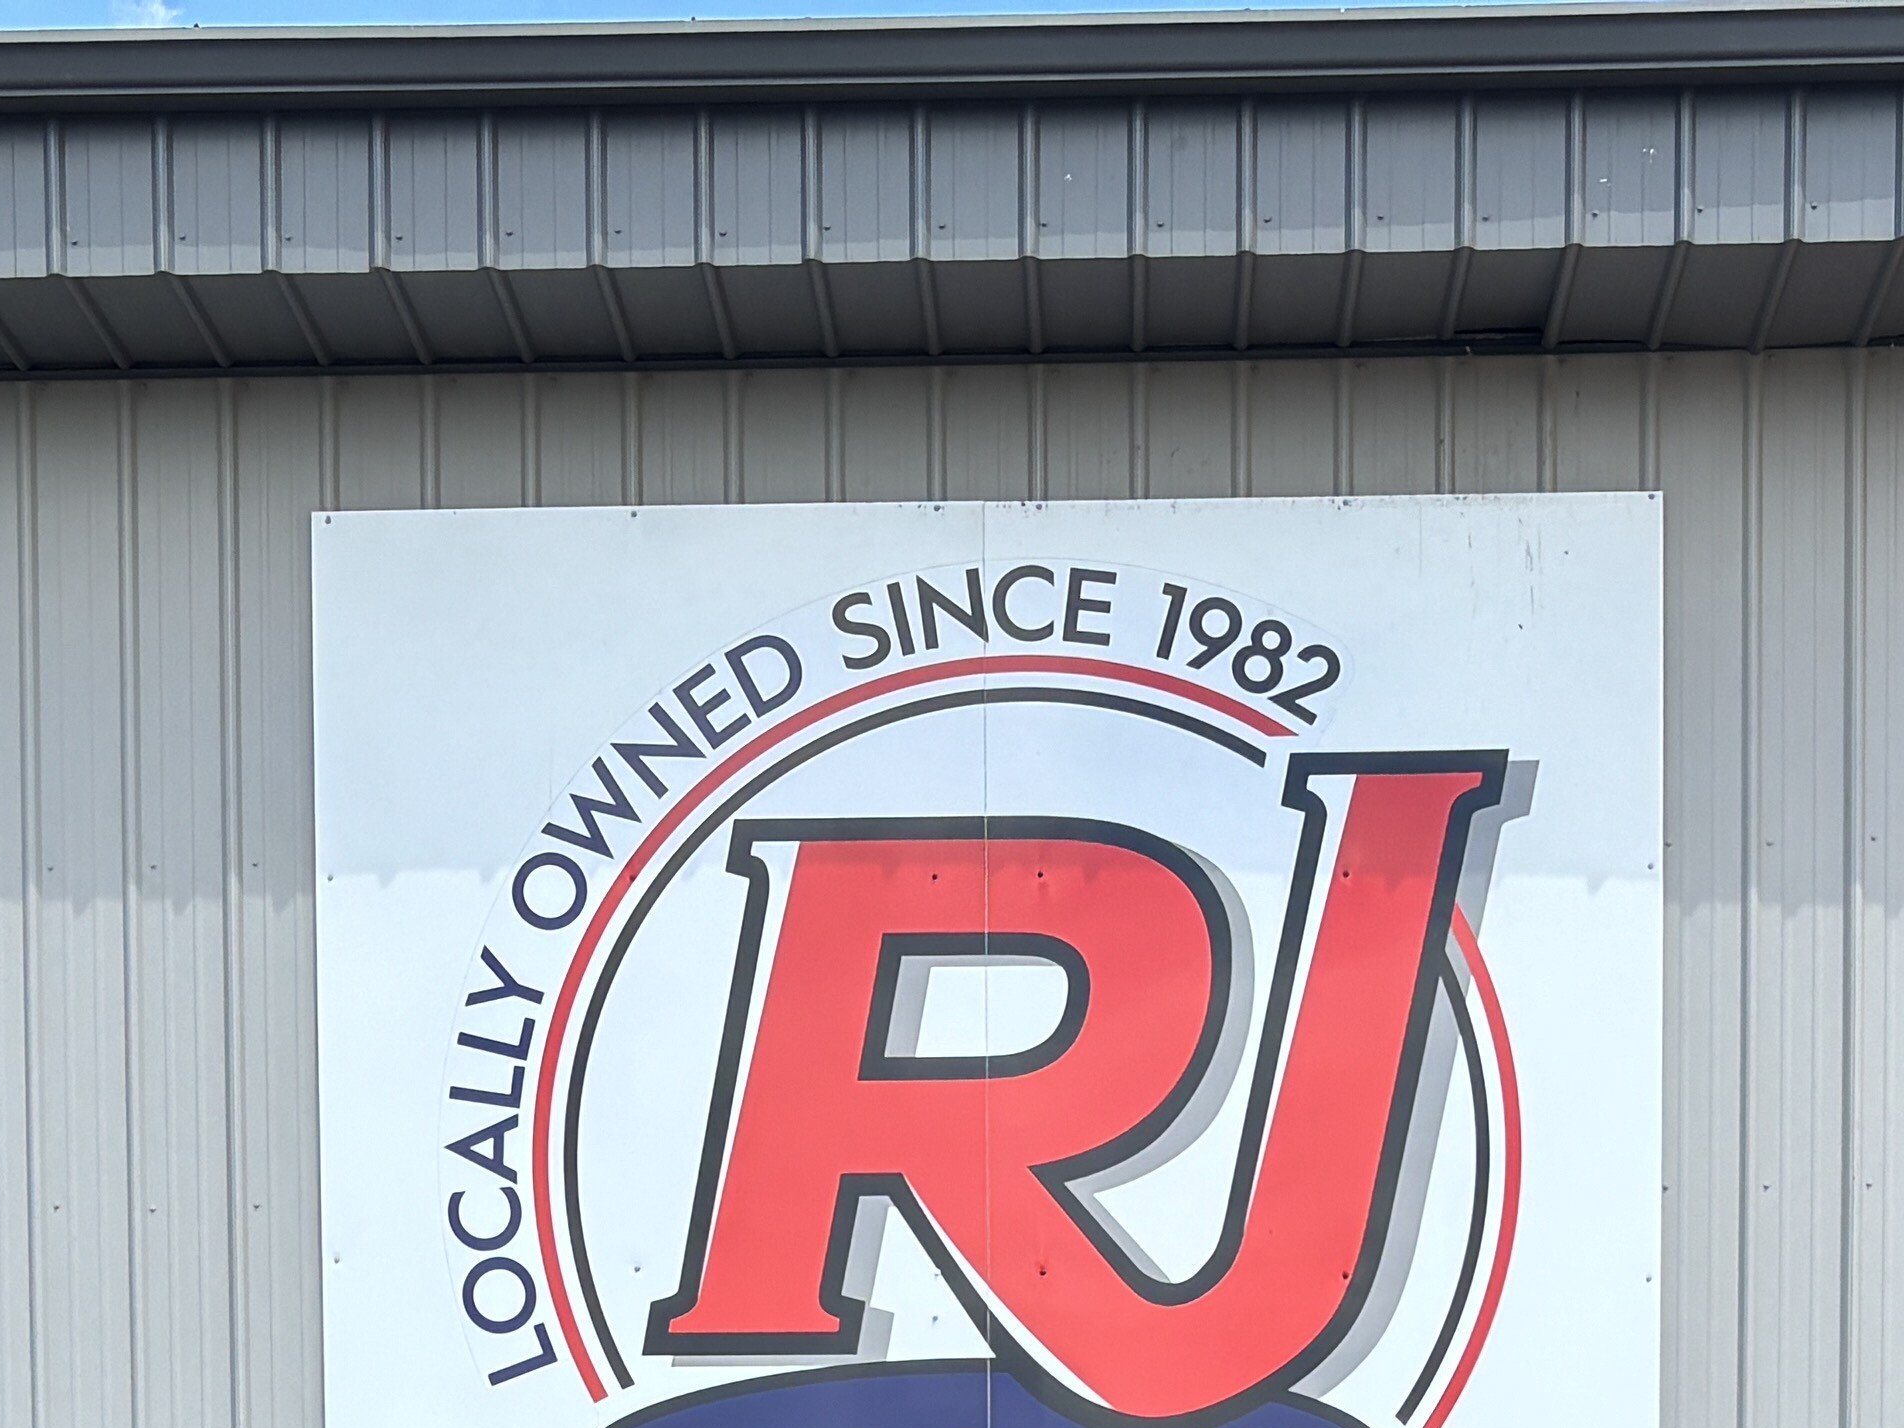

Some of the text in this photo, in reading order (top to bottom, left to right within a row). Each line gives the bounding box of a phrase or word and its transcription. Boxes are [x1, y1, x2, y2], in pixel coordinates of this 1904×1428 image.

[443, 564, 1344, 1387] LOCALLY OWNED SINCE 1982
[642, 749, 1510, 1420] RJ
